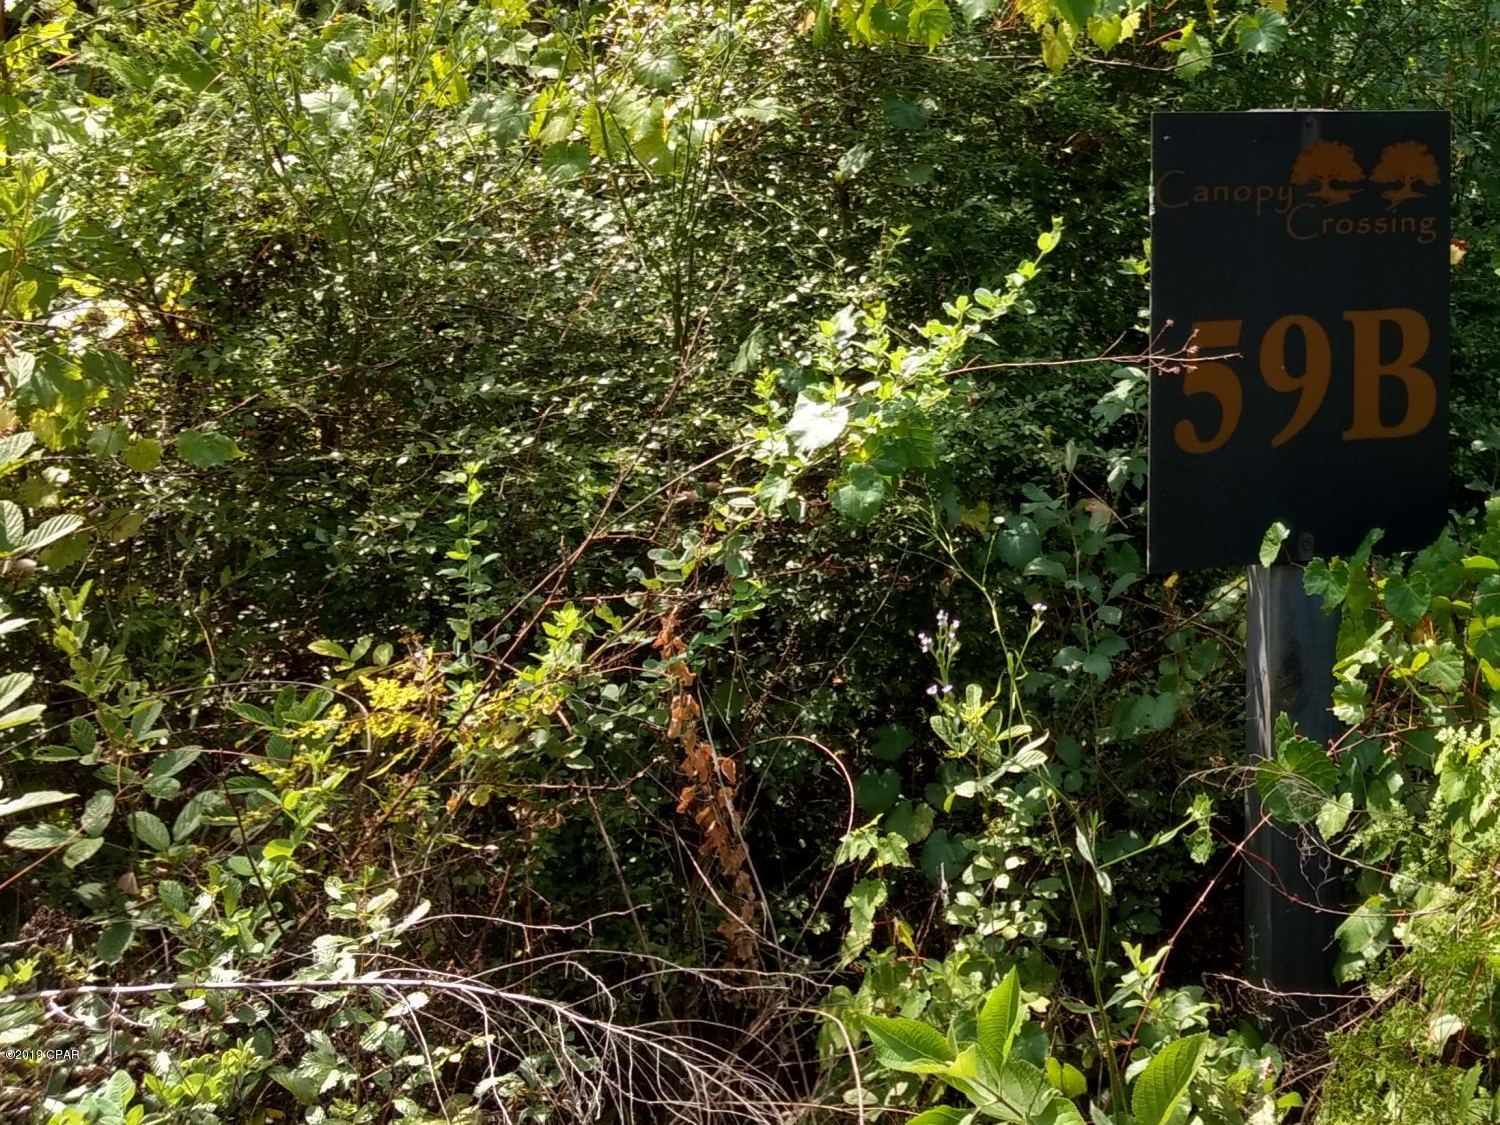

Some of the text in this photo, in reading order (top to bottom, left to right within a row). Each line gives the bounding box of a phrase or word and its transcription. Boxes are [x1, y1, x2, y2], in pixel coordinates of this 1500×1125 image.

[1155, 170, 1294, 216] Canopy
[1286, 203, 1437, 244] Crossing
[1173, 307, 1438, 454] 59B
